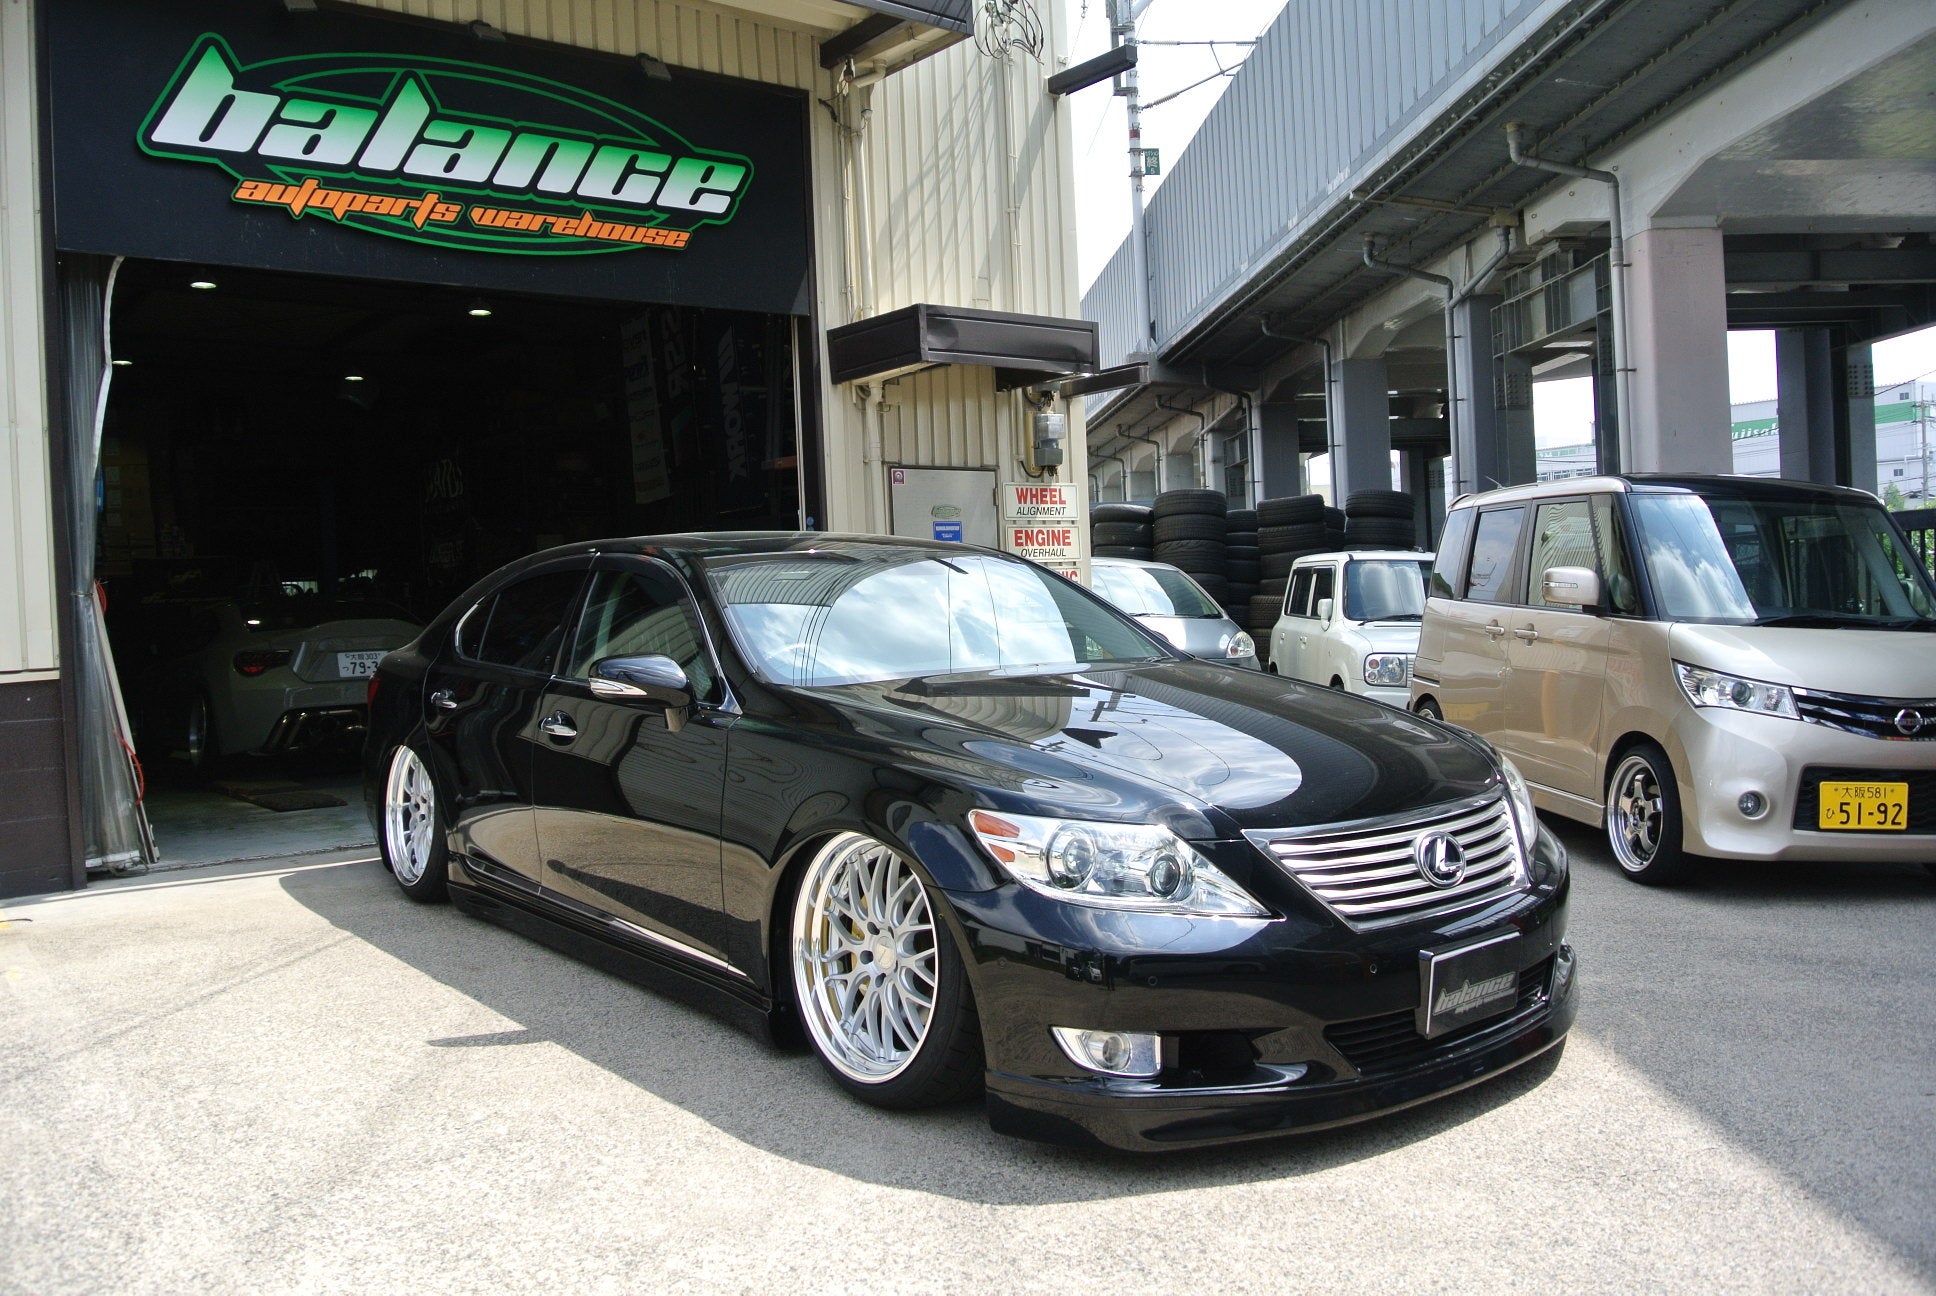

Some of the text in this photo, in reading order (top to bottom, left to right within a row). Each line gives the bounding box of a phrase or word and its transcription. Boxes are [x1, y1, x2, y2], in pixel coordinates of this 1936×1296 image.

[151, 46, 747, 214] balance
[234, 179, 692, 248] autoparts warehouse
[1731, 422, 1778, 440] ujisak
[1016, 488, 1066, 504] WHEEL
[1016, 507, 1066, 515] ALIGNMENT
[1014, 530, 1071, 546] ENGINE
[1021, 549, 1066, 557] OVERHAUL
[350, 662, 379, 674] 79-3
[1842, 787, 1886, 799] 大阪581
[1826, 802, 1903, 825] ひ 51-92
